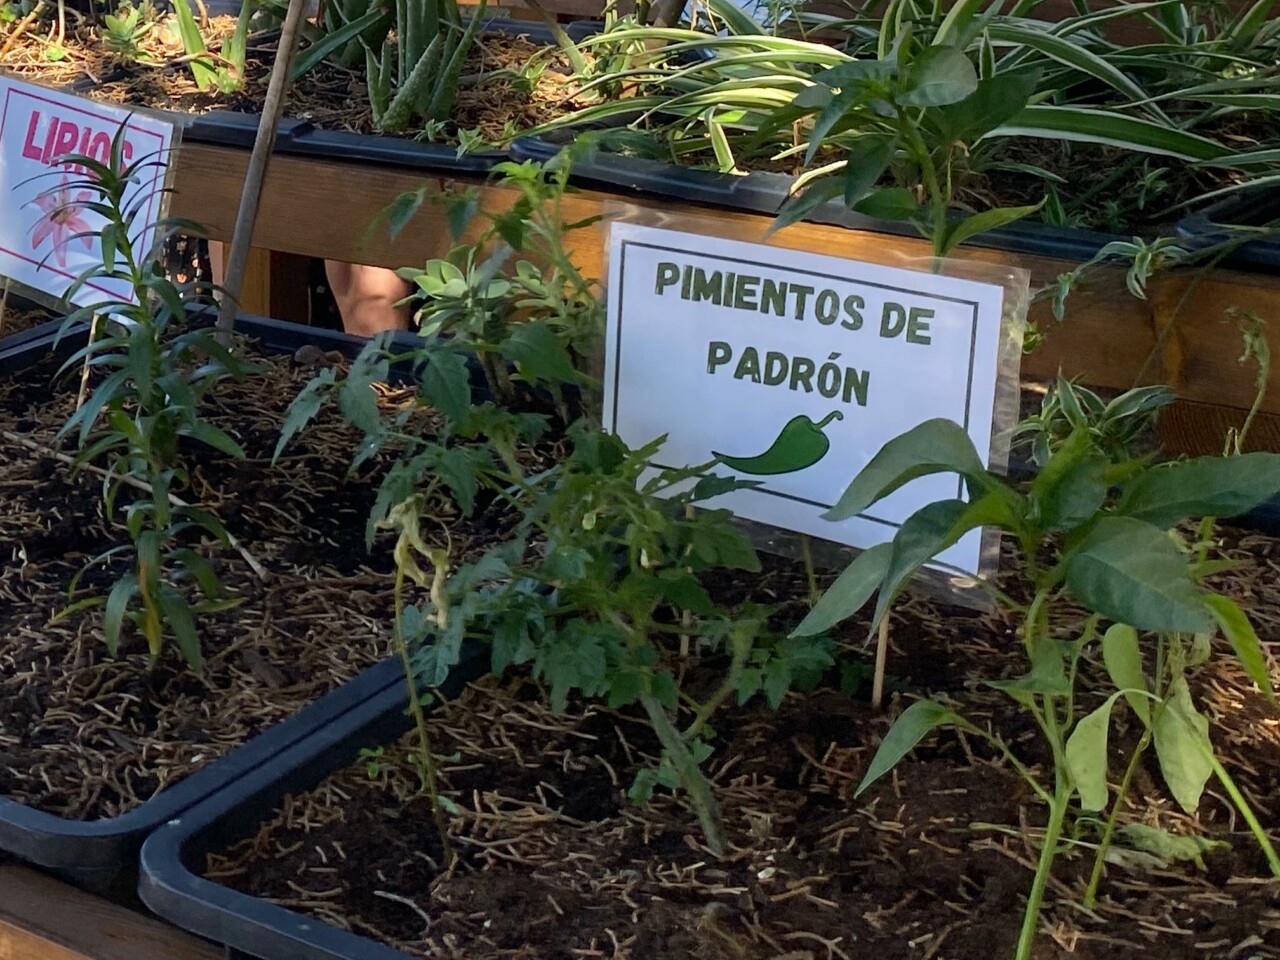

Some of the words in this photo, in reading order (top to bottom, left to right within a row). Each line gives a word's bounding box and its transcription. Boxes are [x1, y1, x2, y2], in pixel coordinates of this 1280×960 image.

[655, 261, 866, 331] PIMIENTOS
[880, 301, 936, 346] DE
[706, 340, 870, 407] PADRÓN
